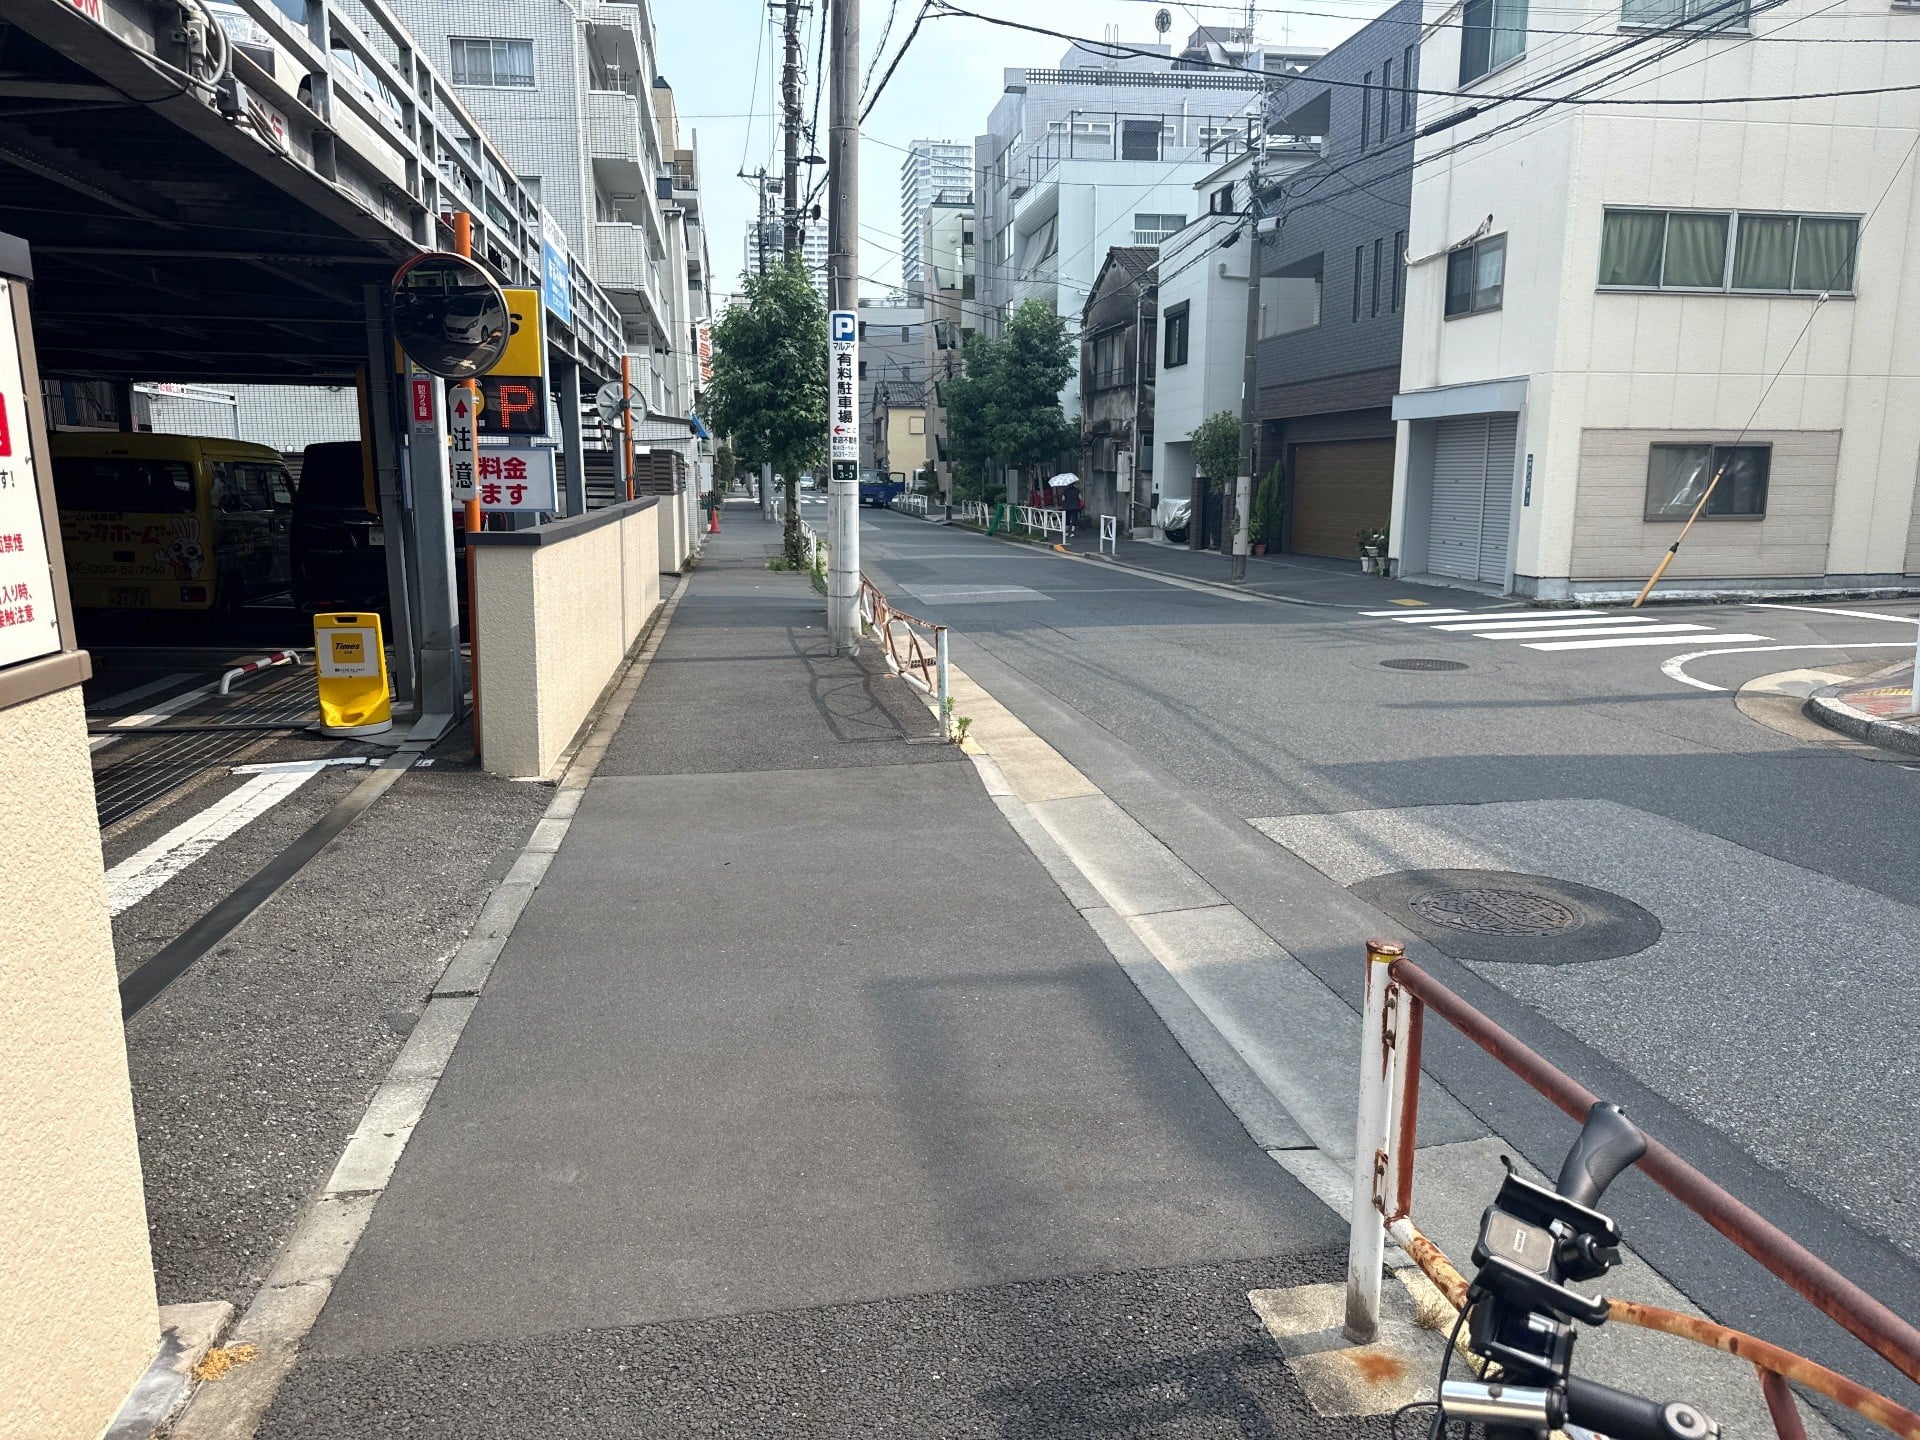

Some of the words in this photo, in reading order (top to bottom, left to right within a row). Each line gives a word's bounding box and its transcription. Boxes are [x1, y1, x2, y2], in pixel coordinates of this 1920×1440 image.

[836, 317, 854, 339] P
[837, 352, 853, 424] 有料駐車場
[500, 385, 535, 430] P
[453, 427, 473, 489] 注意
[0, 582, 33, 605] 入り時、
[335, 642, 360, 650] Times
